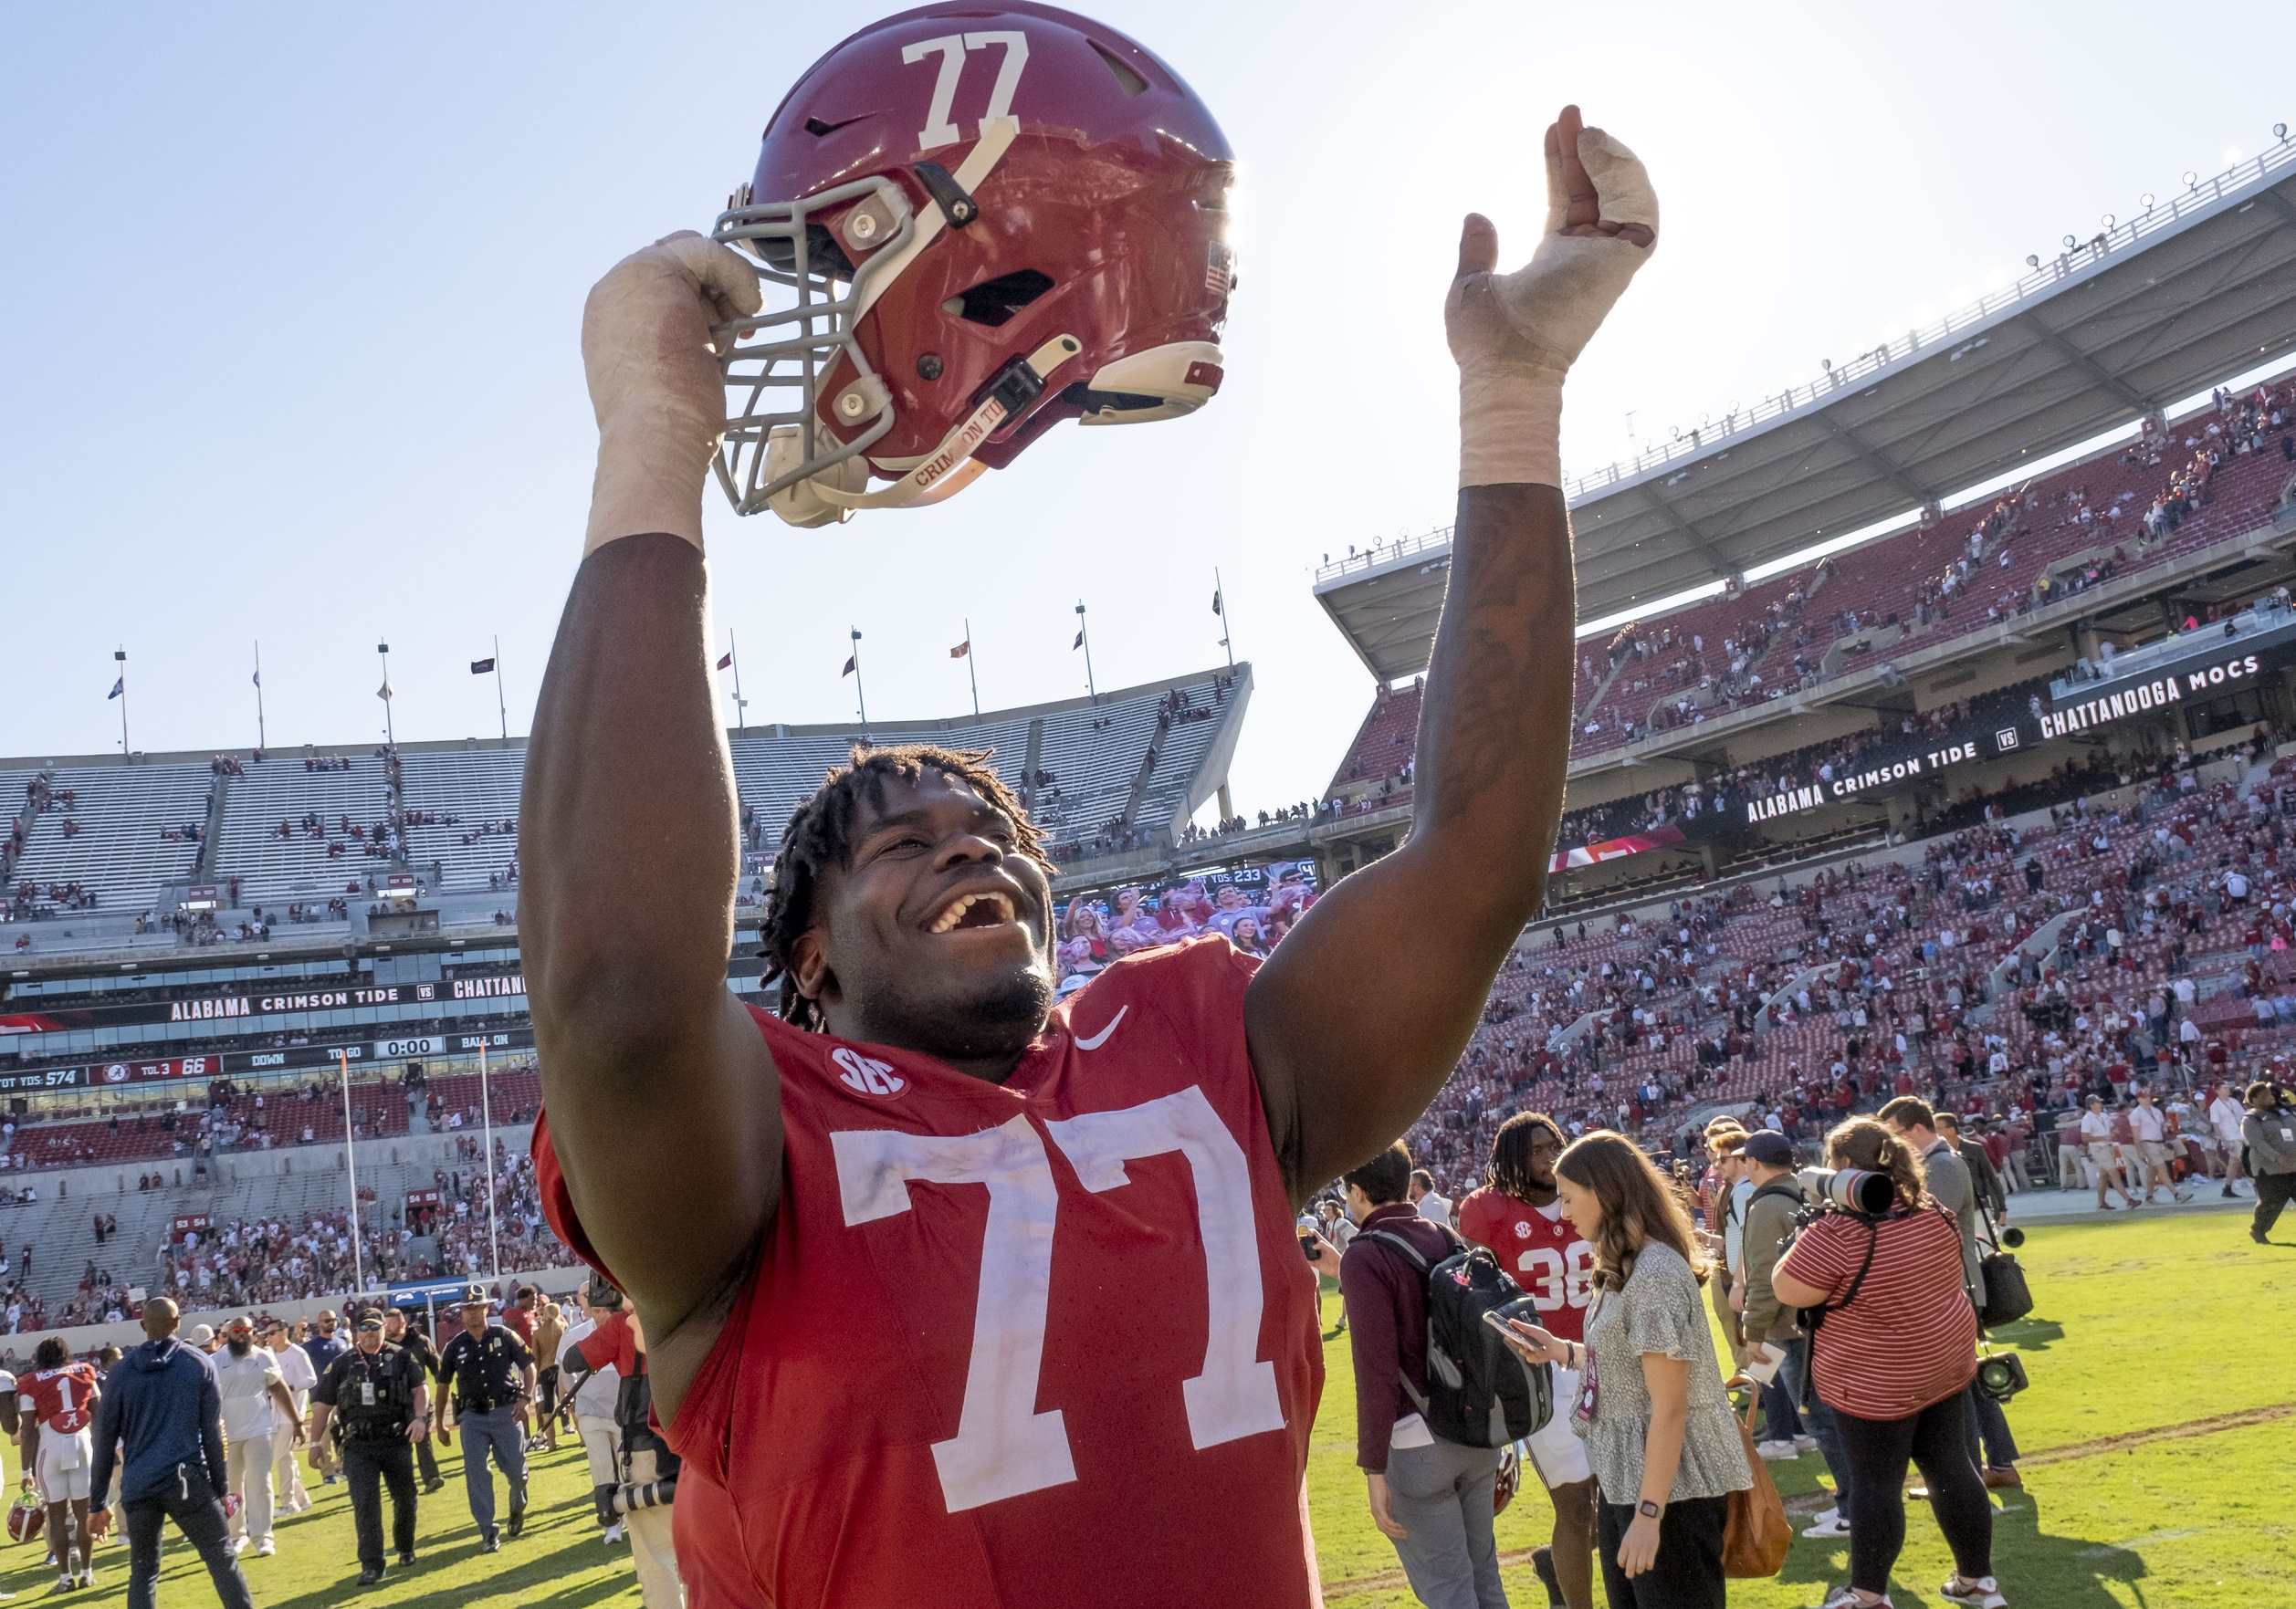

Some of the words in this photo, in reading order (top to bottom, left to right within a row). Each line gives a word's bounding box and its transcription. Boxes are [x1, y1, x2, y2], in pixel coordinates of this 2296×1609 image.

[901, 31, 1030, 150] 77
[915, 421, 984, 486] CRIMON
[1747, 783, 1825, 822] ALABAMA
[1832, 758, 1921, 797] CRIMSON
[1927, 742, 1977, 768] TIDE
[1999, 731, 2015, 747] VS
[2039, 677, 2182, 739] CHATTANOOGA
[2188, 656, 2259, 692] MOCS
[1234, 869, 1261, 883] 233
[171, 998, 251, 1021] ALABAMA
[260, 992, 348, 1011] CRIMSON
[355, 988, 399, 1004] TIDE
[420, 986, 432, 998] VS
[454, 977, 527, 999] CHATTAN
[387, 1039, 431, 1057] 0:00
[493, 1034, 508, 1046] ON
[141, 1065, 160, 1076] TOL
[161, 1063, 171, 1075] 3
[182, 1058, 206, 1075] 66
[252, 1053, 285, 1067] DOWN
[328, 1049, 342, 1060] TO
[346, 1047, 362, 1059] GO
[832, 1047, 905, 1095] SEC
[0, 1077, 16, 1088] OT
[46, 1070, 77, 1086] 574
[1515, 1221, 1532, 1238] SEC
[830, 1084, 1289, 1514] 77
[57, 1376, 77, 1413] 1
